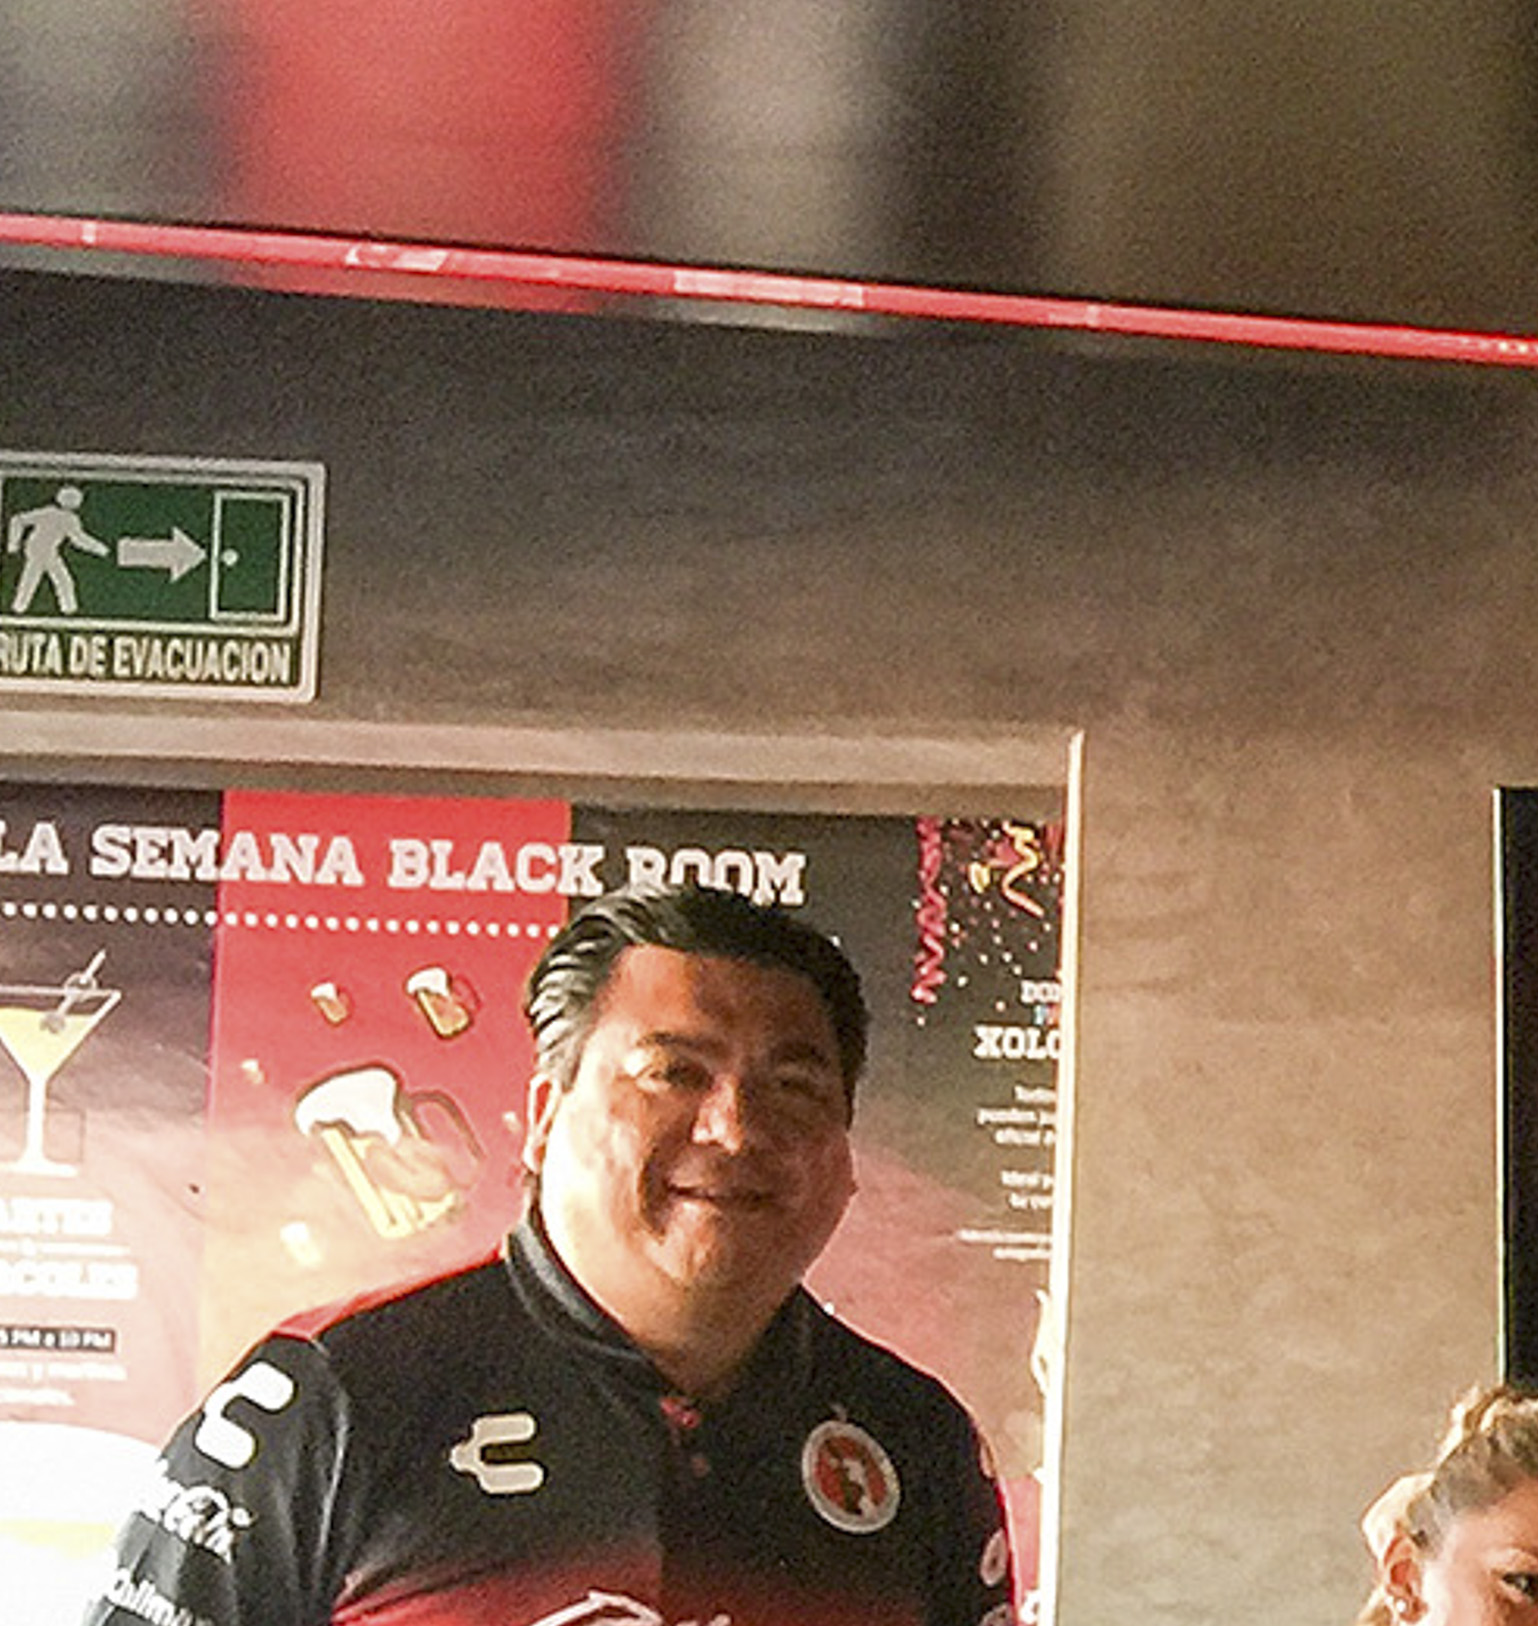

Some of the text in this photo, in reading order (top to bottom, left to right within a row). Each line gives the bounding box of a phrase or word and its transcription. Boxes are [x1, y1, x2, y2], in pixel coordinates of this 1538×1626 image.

[69, 634, 108, 677] DE
[113, 636, 291, 684] EVACUACION
[90, 823, 366, 887] SEMANA
[388, 839, 605, 898] BLACK
[625, 845, 807, 907] ROOM
